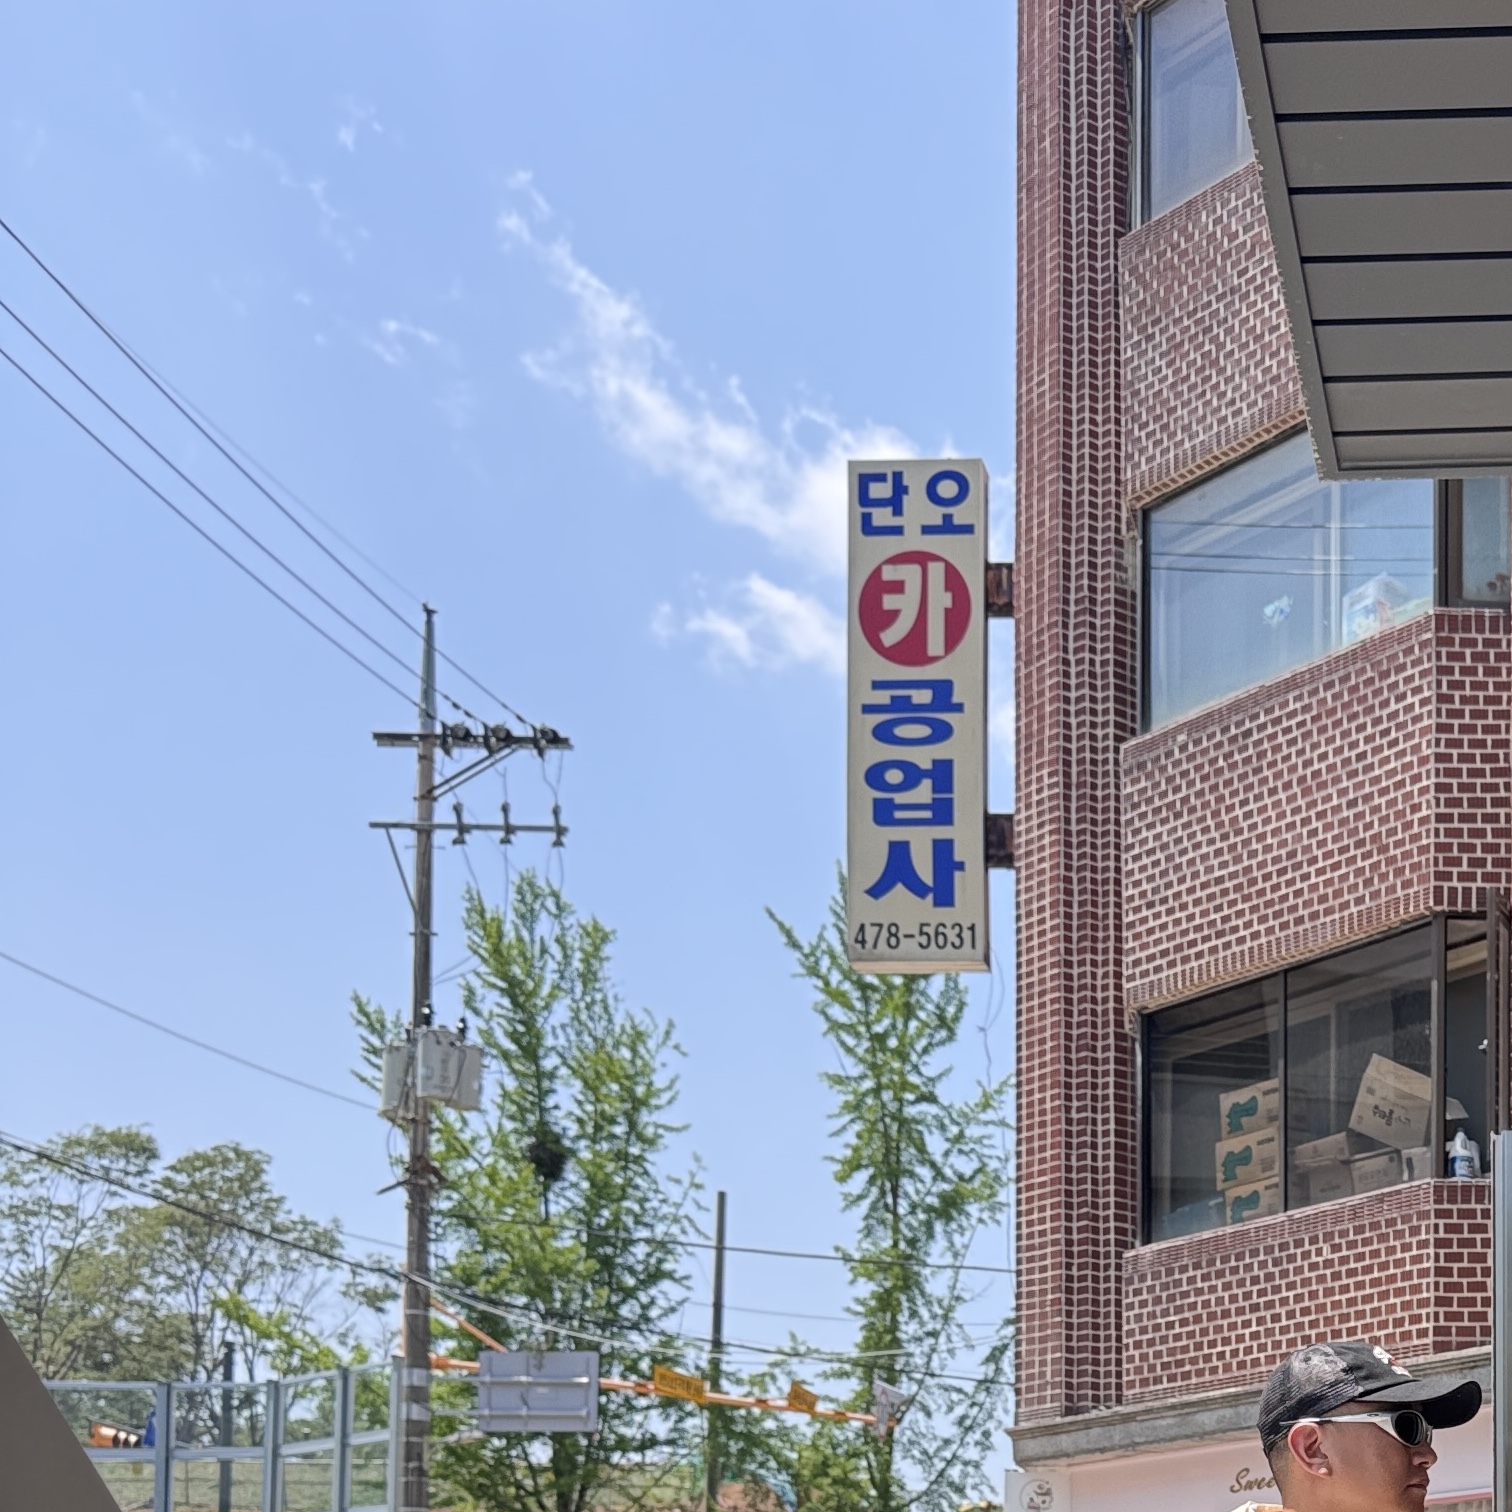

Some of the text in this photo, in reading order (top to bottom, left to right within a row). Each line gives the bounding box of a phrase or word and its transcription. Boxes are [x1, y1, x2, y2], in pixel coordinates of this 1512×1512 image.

[857, 470, 975, 536] 단오
[861, 562, 965, 908] 카 공업사
[854, 922, 976, 950] 478-5631
